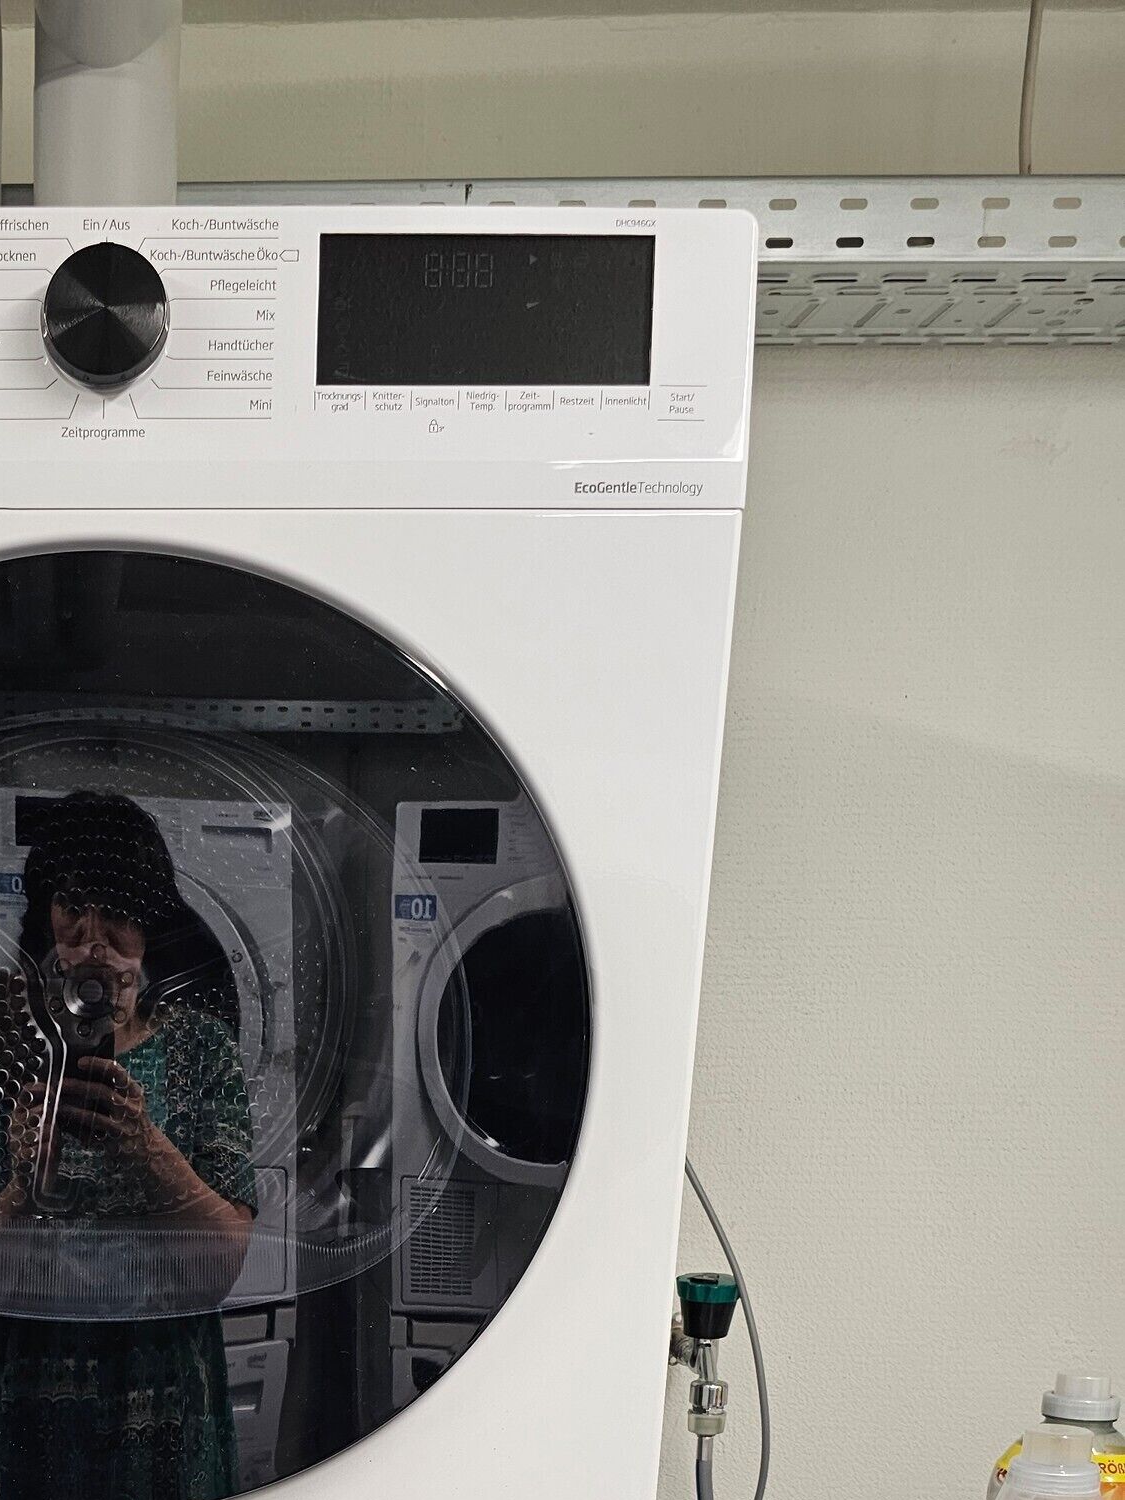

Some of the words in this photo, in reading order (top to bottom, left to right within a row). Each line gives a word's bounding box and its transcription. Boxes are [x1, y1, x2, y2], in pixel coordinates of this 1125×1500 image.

[83, 219, 99, 231] Ein
[108, 219, 131, 231] Aus
[171, 218, 279, 231] Koch-/Buntwäsche
[149, 249, 255, 262] Koch-/Buntwäsche
[256, 247, 278, 262] Öko
[210, 279, 277, 293] Pflegeleicht
[256, 310, 276, 321] Mix
[208, 339, 274, 352] Handtücher
[207, 369, 273, 382] Feinwäsche
[317, 391, 363, 402] Trocknungs-
[372, 391, 405, 401] Knitter-
[466, 391, 499, 401] Niedrig-
[519, 391, 540, 400] Zeit-
[670, 392, 695, 402] Start/
[249, 400, 272, 410] Mini
[415, 398, 455, 408] Signalton
[559, 397, 595, 406] Restzeit
[605, 397, 647, 406] Innenlicht
[331, 403, 349, 412] grad
[375, 403, 403, 411] schutz
[470, 403, 496, 412] Temp.
[508, 403, 551, 412] programm
[669, 405, 694, 414] Pause
[61, 427, 146, 440] Zeitprogramme
[574, 481, 704, 497] EcoGentleTechnology
